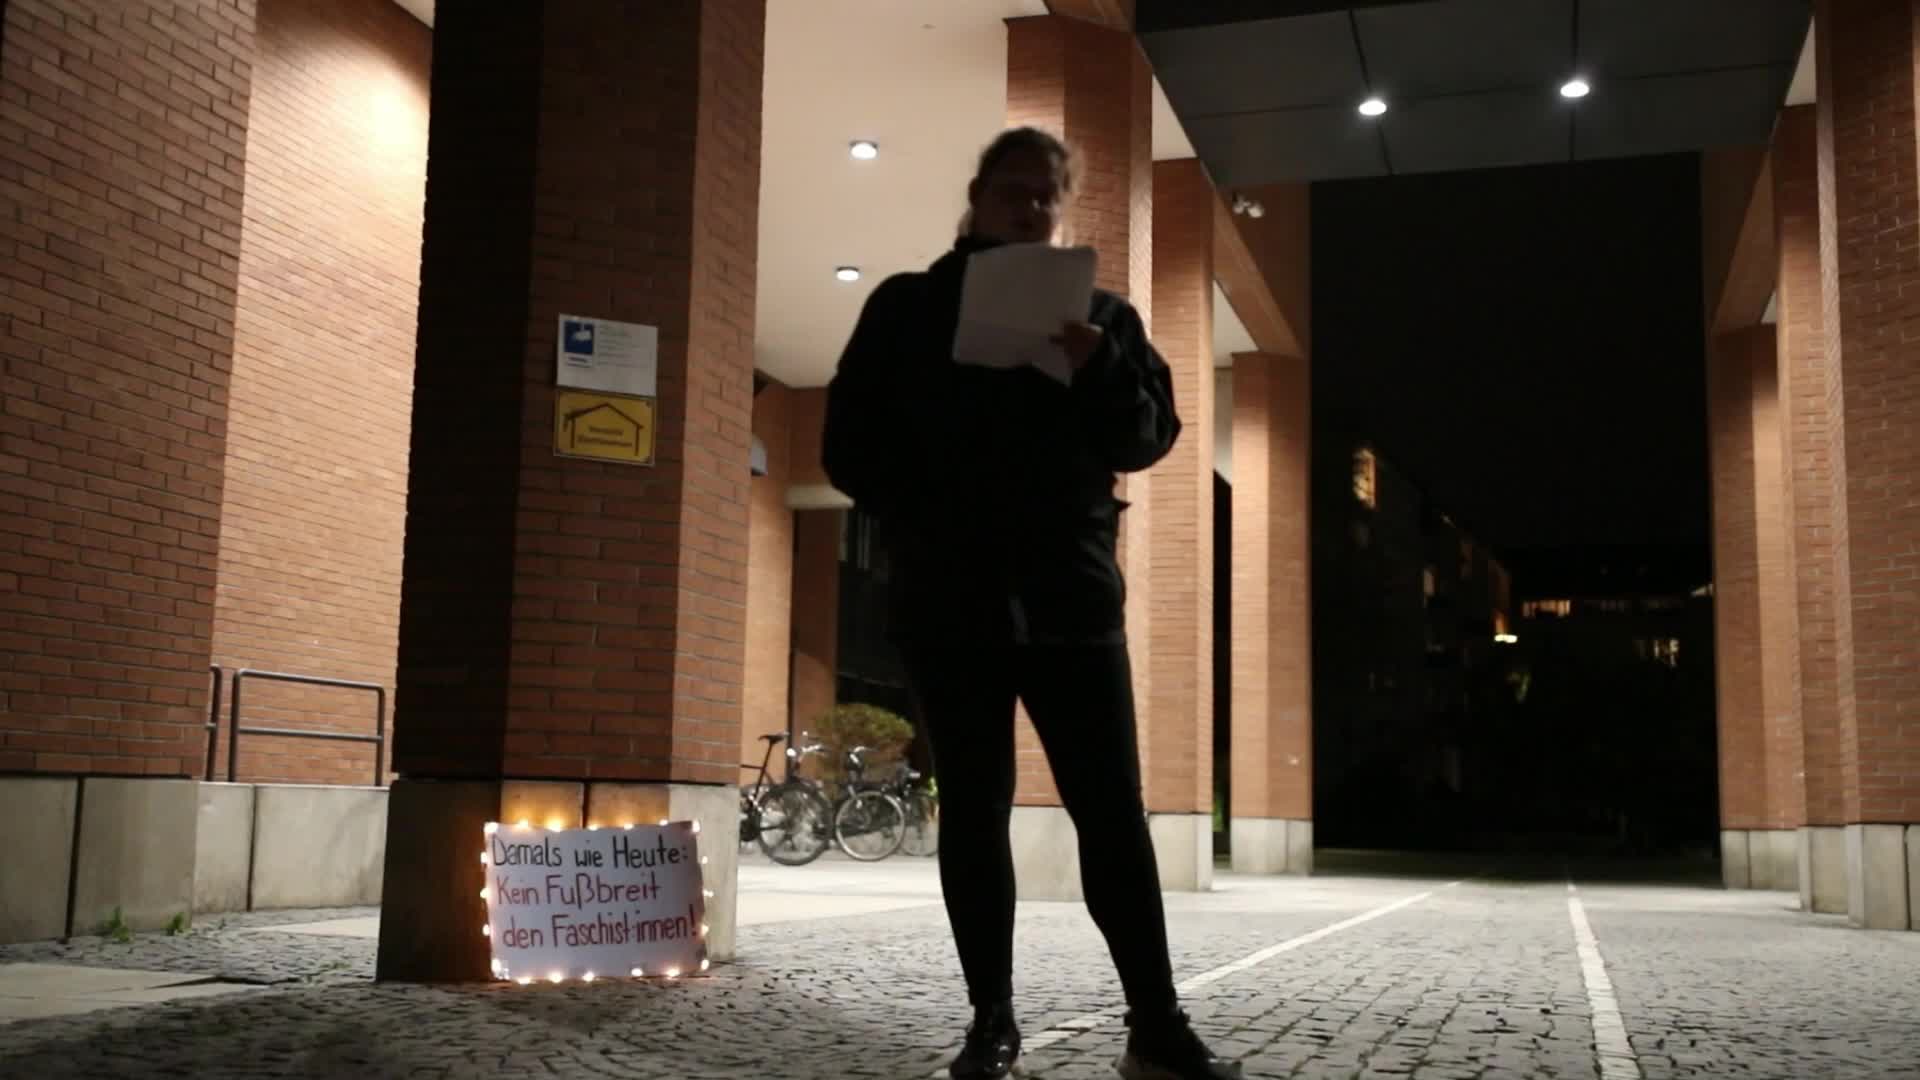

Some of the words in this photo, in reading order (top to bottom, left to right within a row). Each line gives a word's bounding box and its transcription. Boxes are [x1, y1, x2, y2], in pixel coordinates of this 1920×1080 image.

[491, 834, 563, 868] Damals
[575, 840, 604, 866] wie
[612, 834, 689, 869] Heute:
[497, 876, 540, 905] Kein
[545, 872, 661, 910] Fußbreit
[502, 915, 543, 948] den
